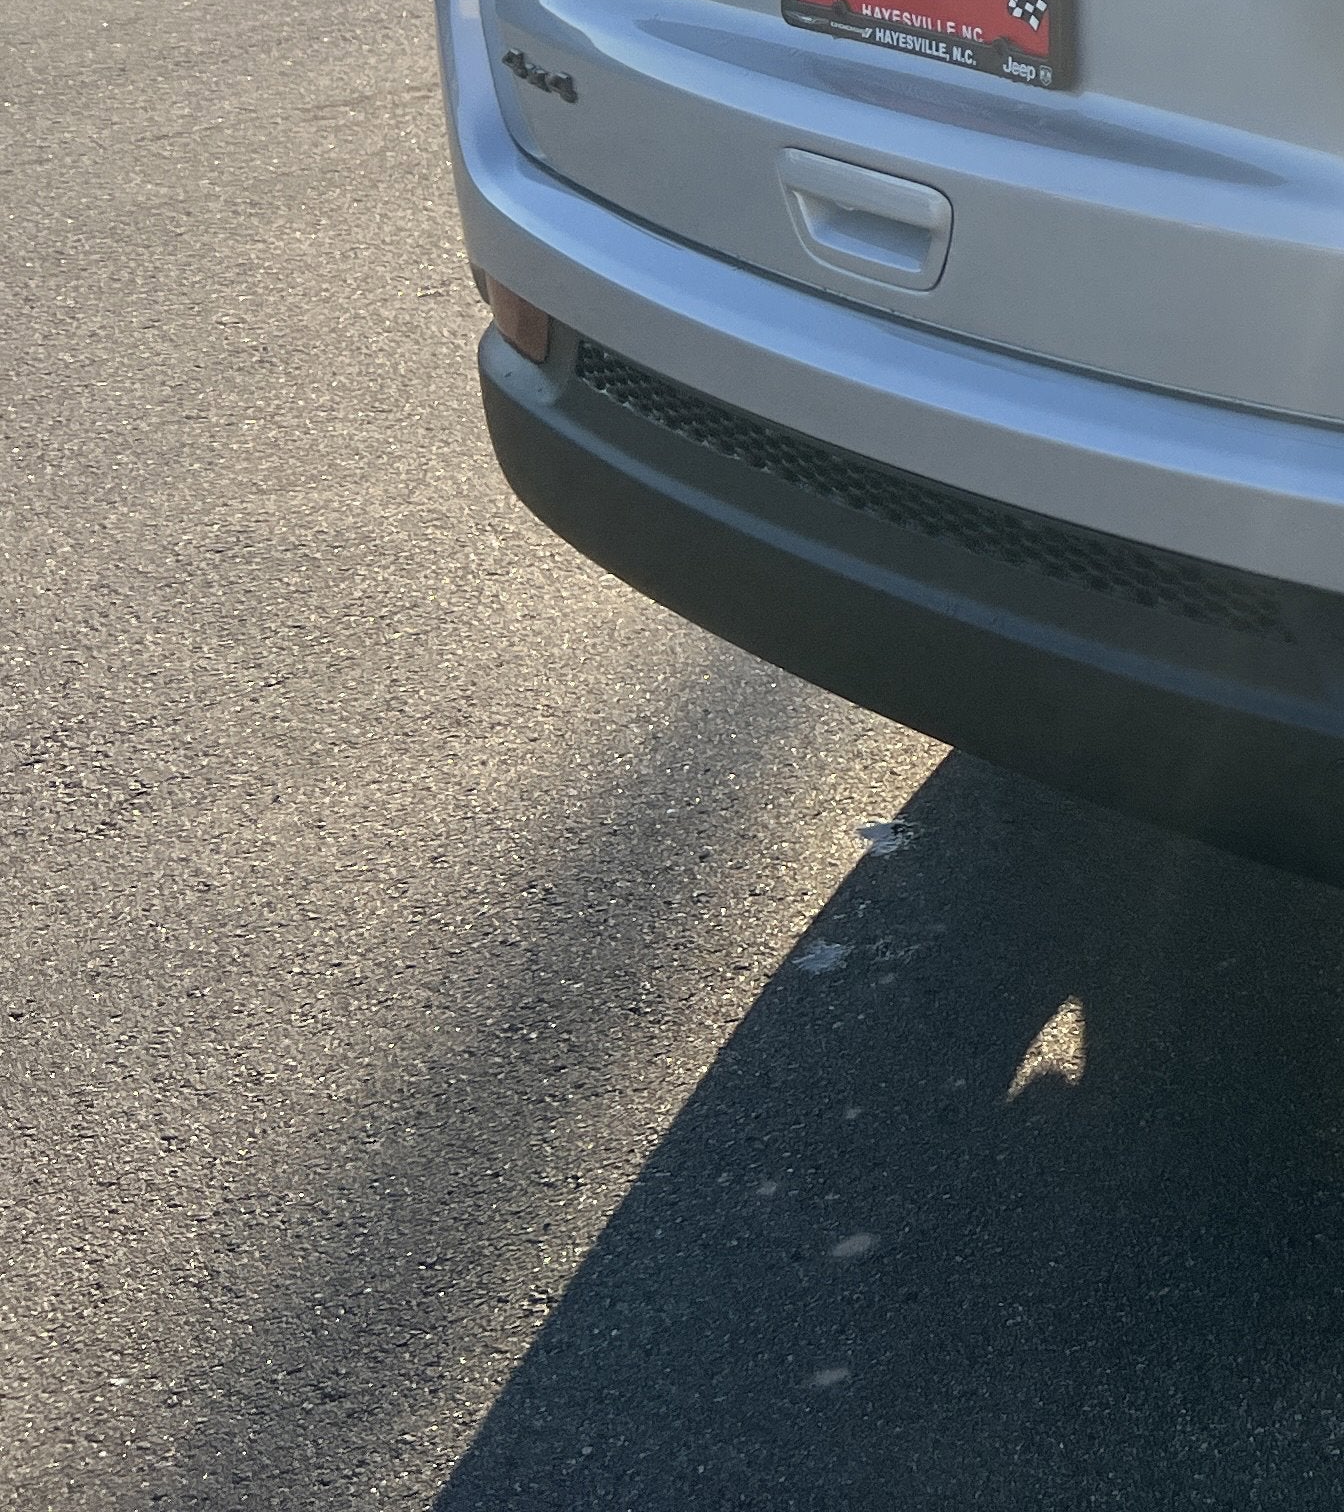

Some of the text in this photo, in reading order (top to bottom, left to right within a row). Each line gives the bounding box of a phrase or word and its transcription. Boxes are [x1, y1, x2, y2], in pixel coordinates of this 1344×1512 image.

[875, 27, 950, 61] HAYESVILLE,
[952, 46, 977, 66] N.C.
[1002, 56, 1036, 81] Jeep
